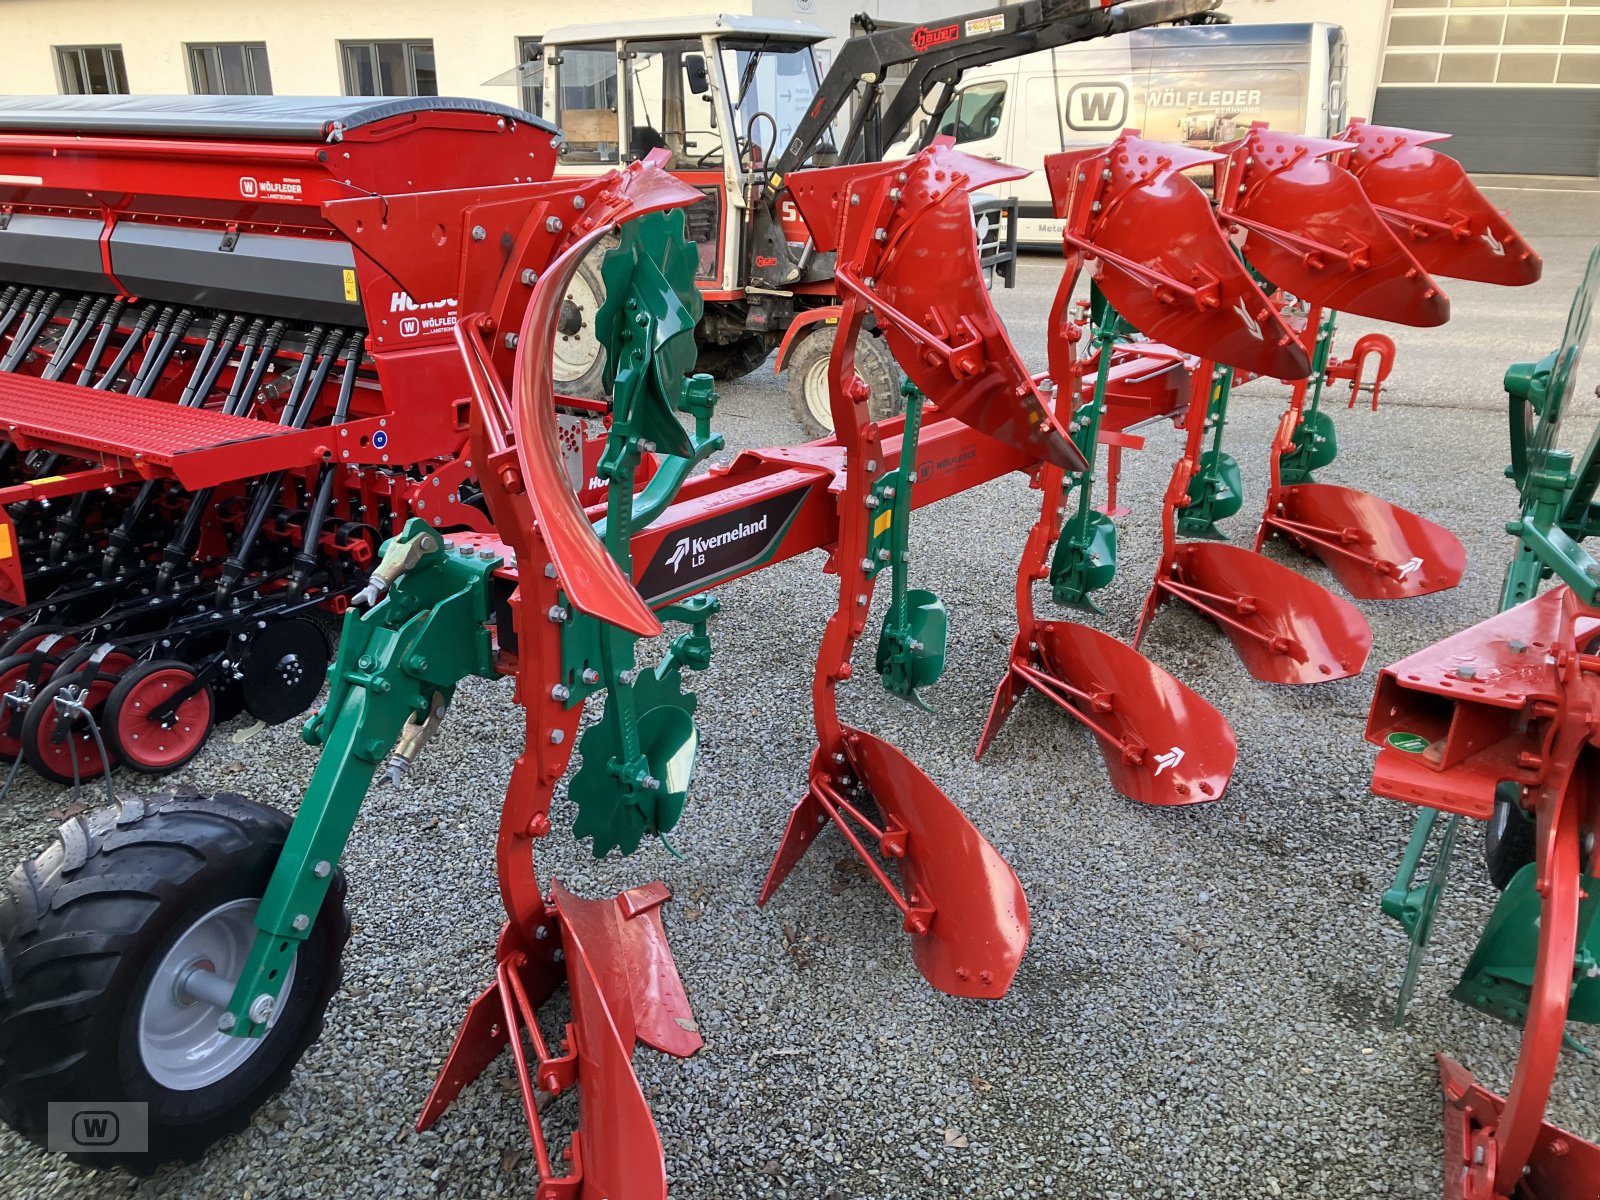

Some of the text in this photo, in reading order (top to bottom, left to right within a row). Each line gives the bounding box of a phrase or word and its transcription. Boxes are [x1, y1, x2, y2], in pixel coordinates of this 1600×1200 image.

[914, 26, 958, 48] hauer
[1149, 88, 1261, 107] WÖLFLEDER
[1081, 92, 1117, 121] W
[1215, 106, 1260, 114] BERNHARD
[243, 181, 253, 193] W
[259, 181, 302, 194] WÖLFLEDER
[782, 201, 804, 222] S
[404, 321, 415, 333] W
[692, 515, 767, 555] Kverneland
[692, 554, 706, 568] LB
